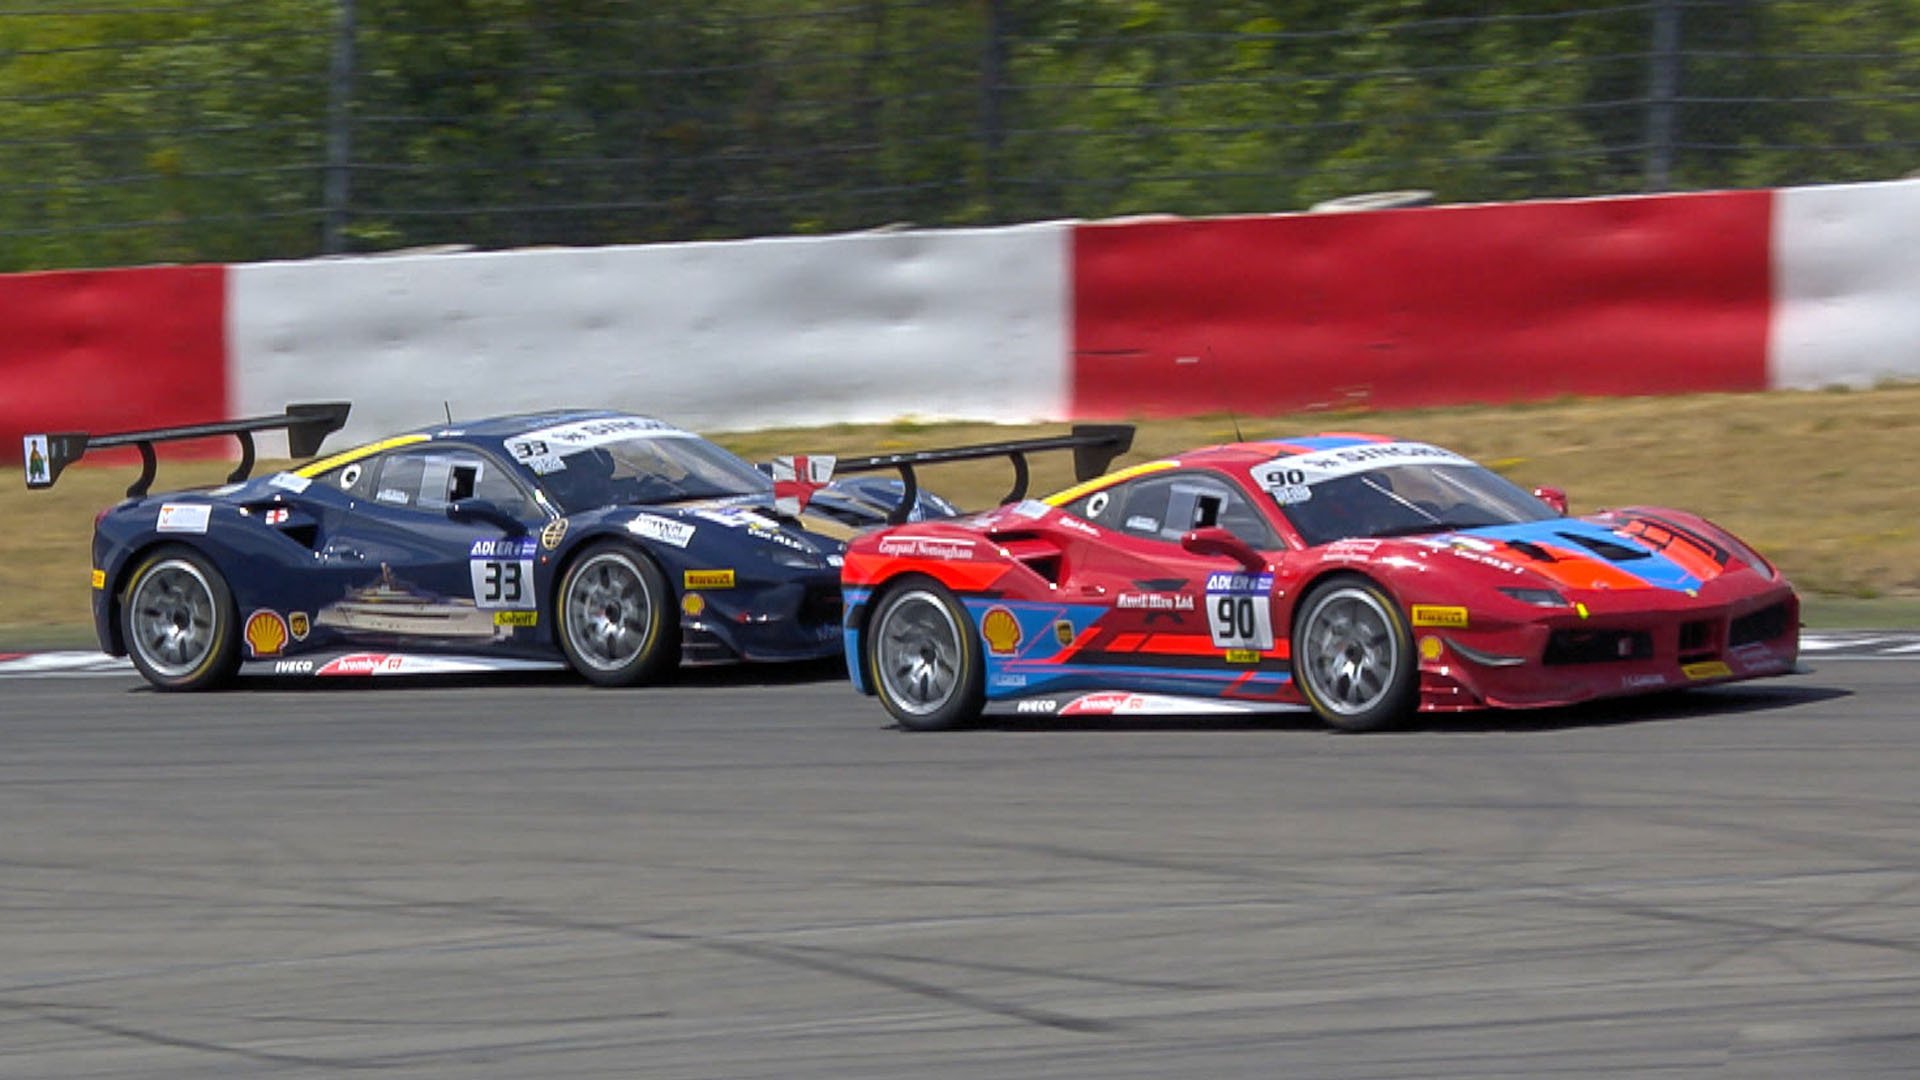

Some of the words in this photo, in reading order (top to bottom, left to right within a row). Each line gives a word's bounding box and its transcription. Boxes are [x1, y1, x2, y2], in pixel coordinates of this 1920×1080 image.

[514, 441, 548, 459] 33
[1266, 469, 1305, 486] 90
[471, 541, 514, 556] ADLER
[485, 562, 521, 602] 33
[1206, 575, 1248, 590] ADLER
[1175, 594, 1194, 610] Ltd
[1218, 597, 1254, 639] 90
[275, 661, 313, 674] IVECO
[1017, 700, 1057, 713] IVECO
